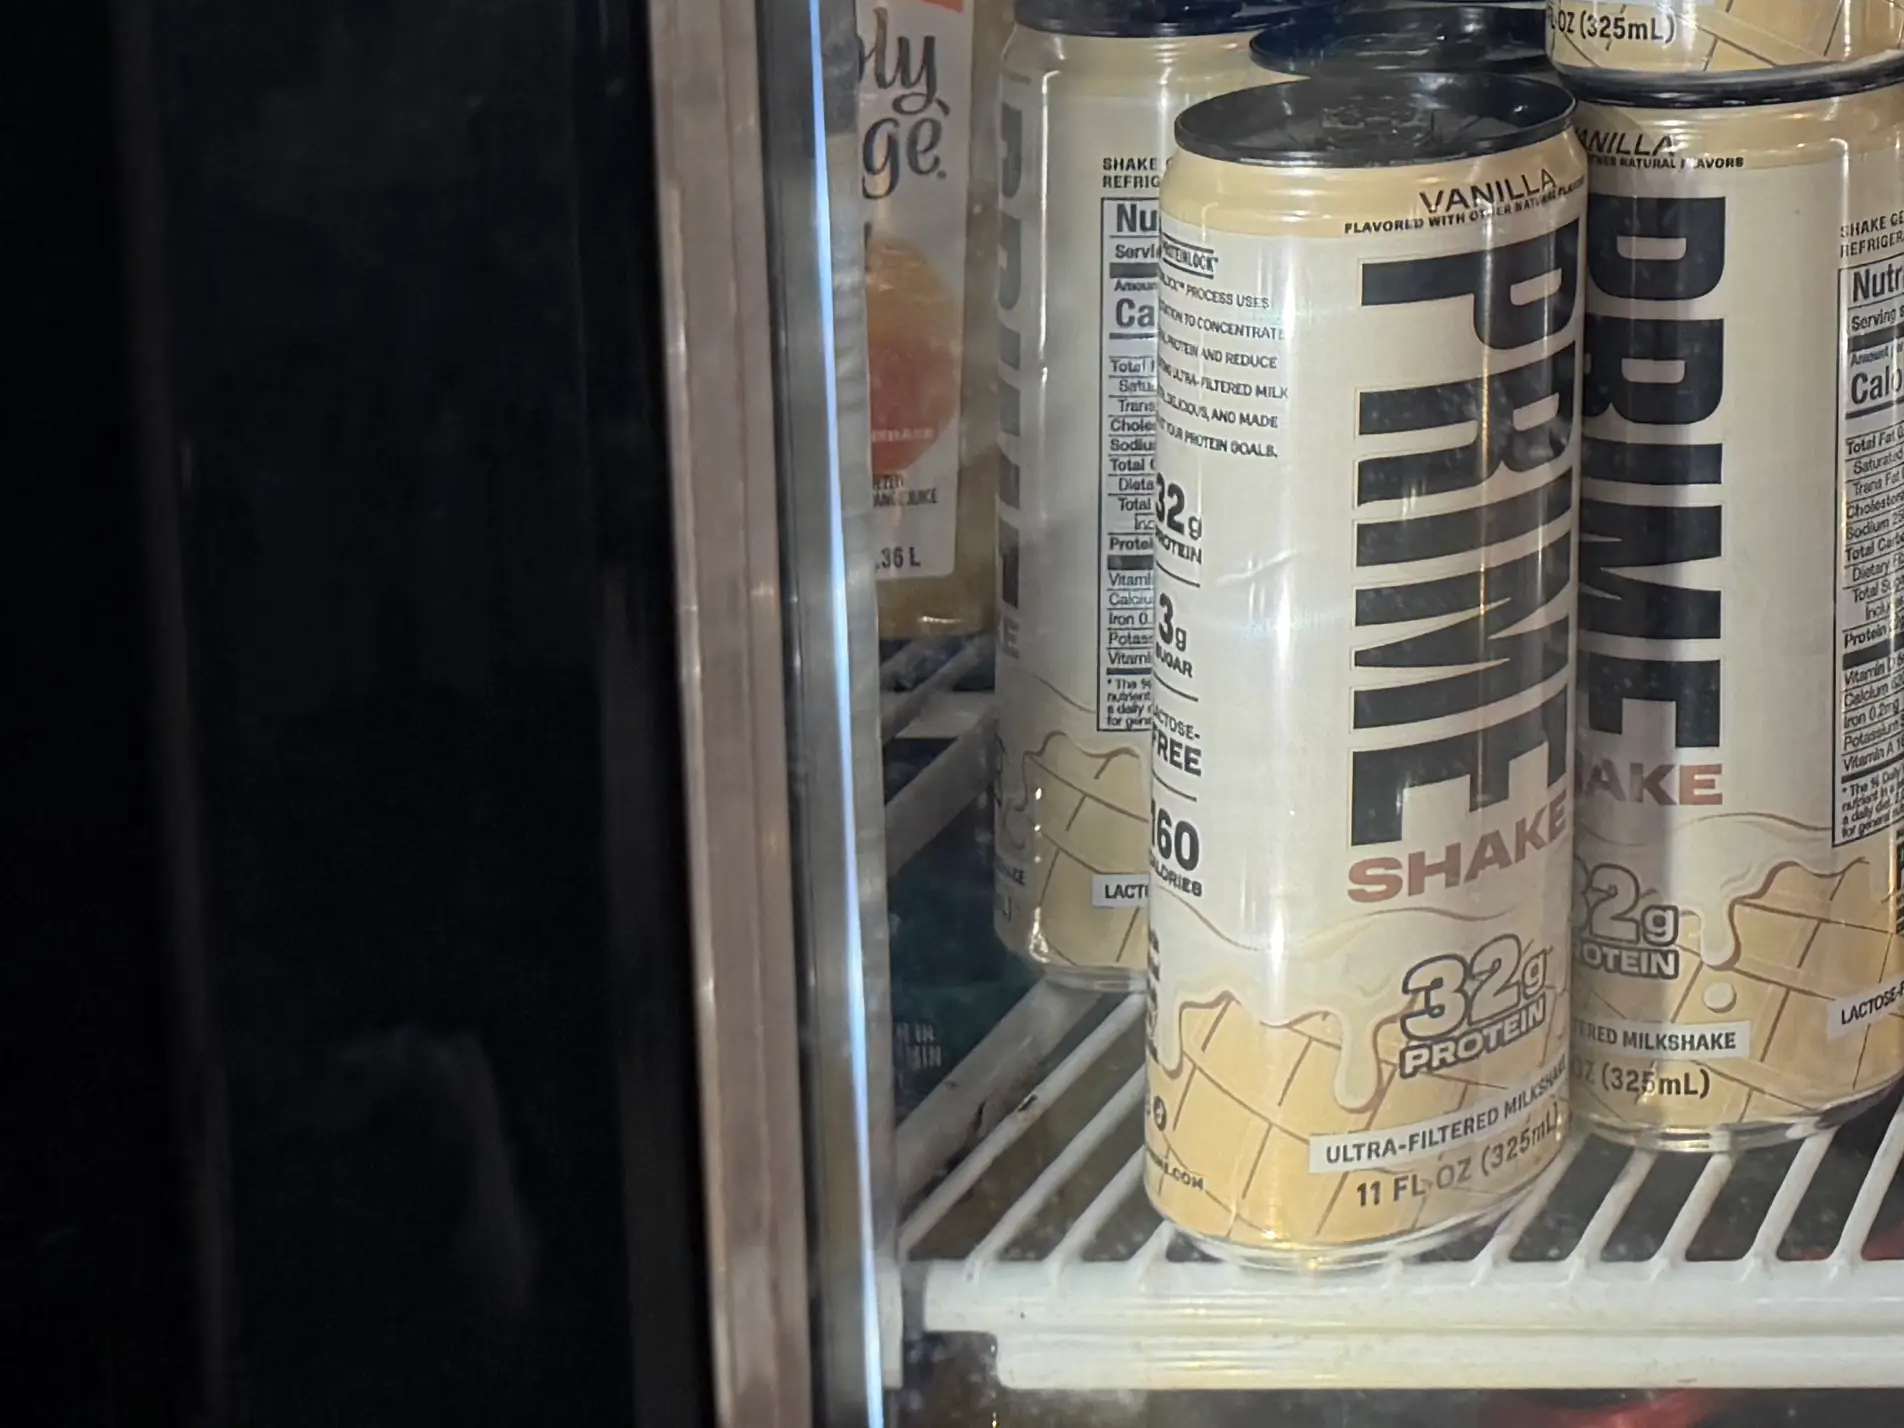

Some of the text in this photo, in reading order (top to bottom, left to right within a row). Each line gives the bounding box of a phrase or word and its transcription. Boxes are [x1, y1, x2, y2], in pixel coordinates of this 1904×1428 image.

[1419, 167, 1558, 214] VANILLA
[1235, 293, 1270, 309] USES
[1224, 352, 1279, 371] REDUCE
[1256, 385, 1289, 400] MILK
[1238, 413, 1279, 429] MADE
[1352, 220, 1577, 847] PRIME
[875, 546, 921, 574] .36 L
[1157, 593, 1188, 653] 3g
[1152, 727, 1203, 777] FREE
[1346, 789, 1568, 904] SHAKE
[1400, 933, 1547, 1040] 32g
[1399, 996, 1547, 1080] PROTEIN
